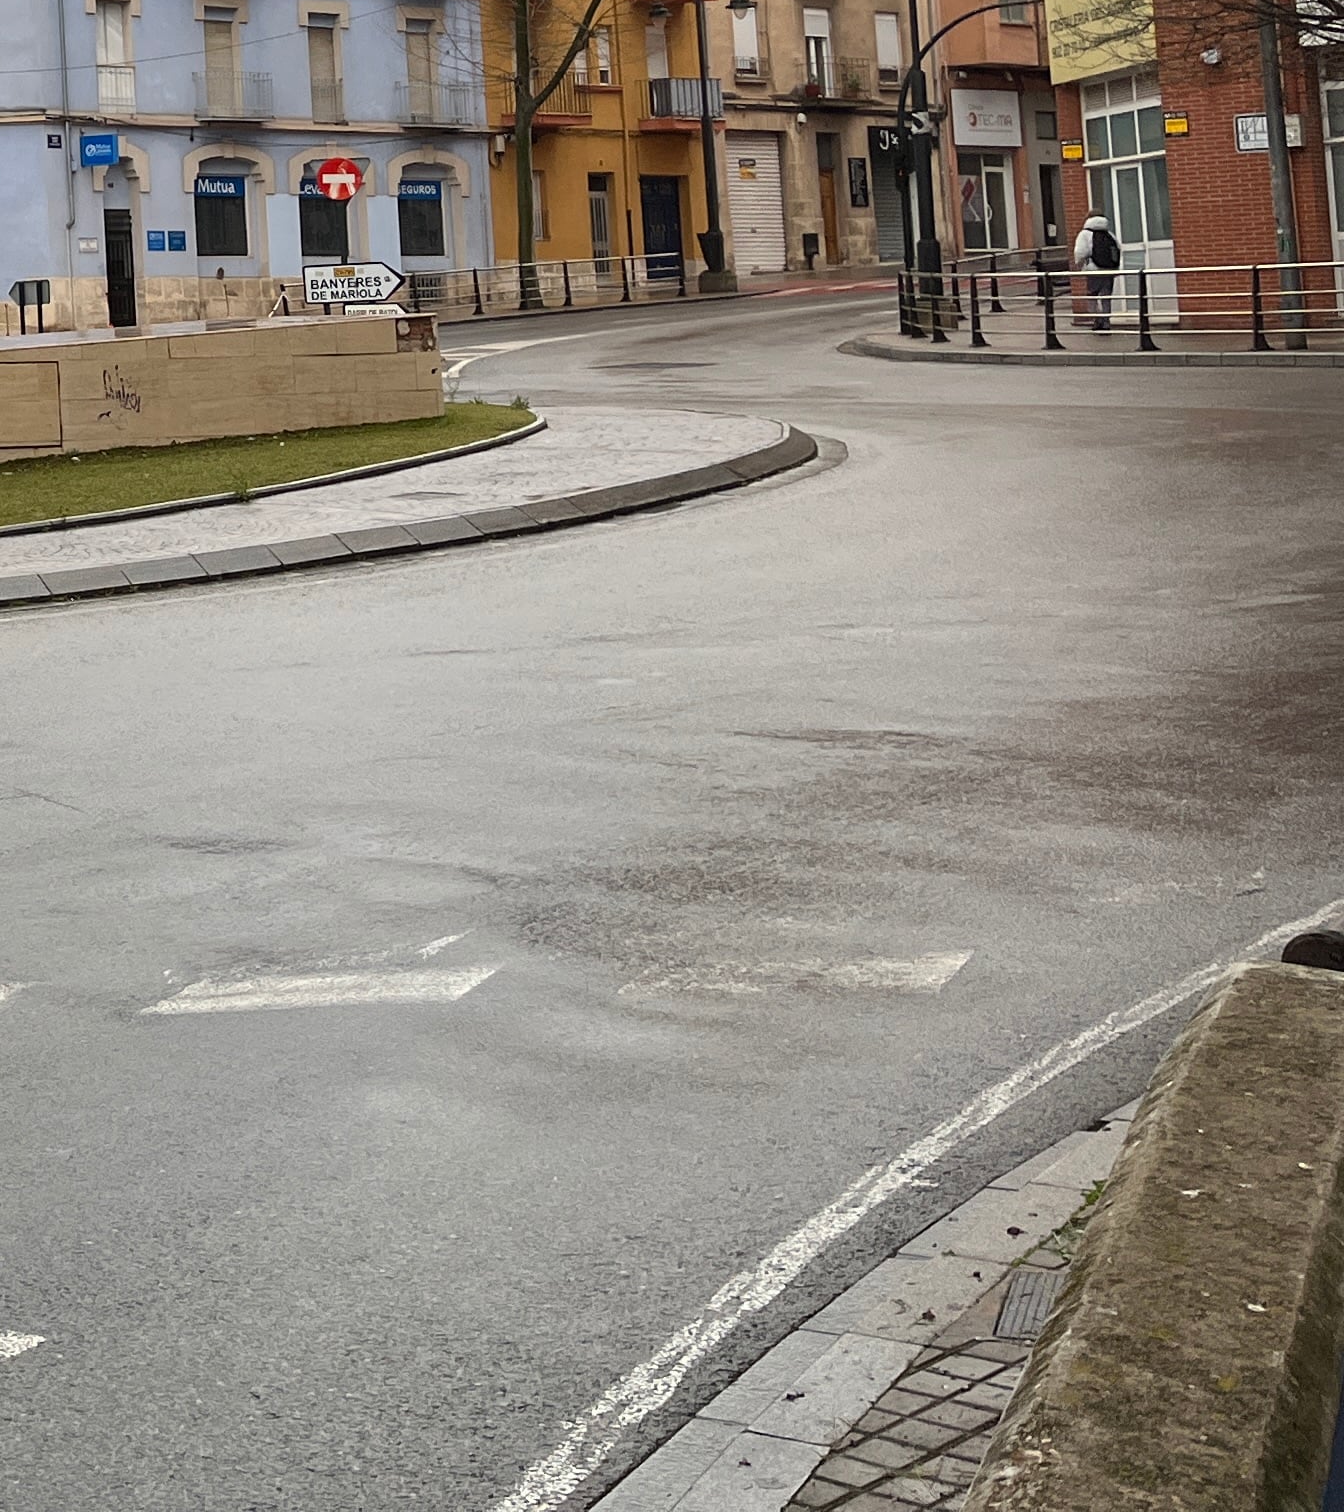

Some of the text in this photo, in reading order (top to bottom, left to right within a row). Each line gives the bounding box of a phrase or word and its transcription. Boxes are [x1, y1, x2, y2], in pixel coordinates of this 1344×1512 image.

[197, 177, 236, 194] Mutua
[401, 184, 437, 195] EGUROS
[310, 276, 382, 290] BANYERES
[311, 288, 383, 301] DE MARIOLA
